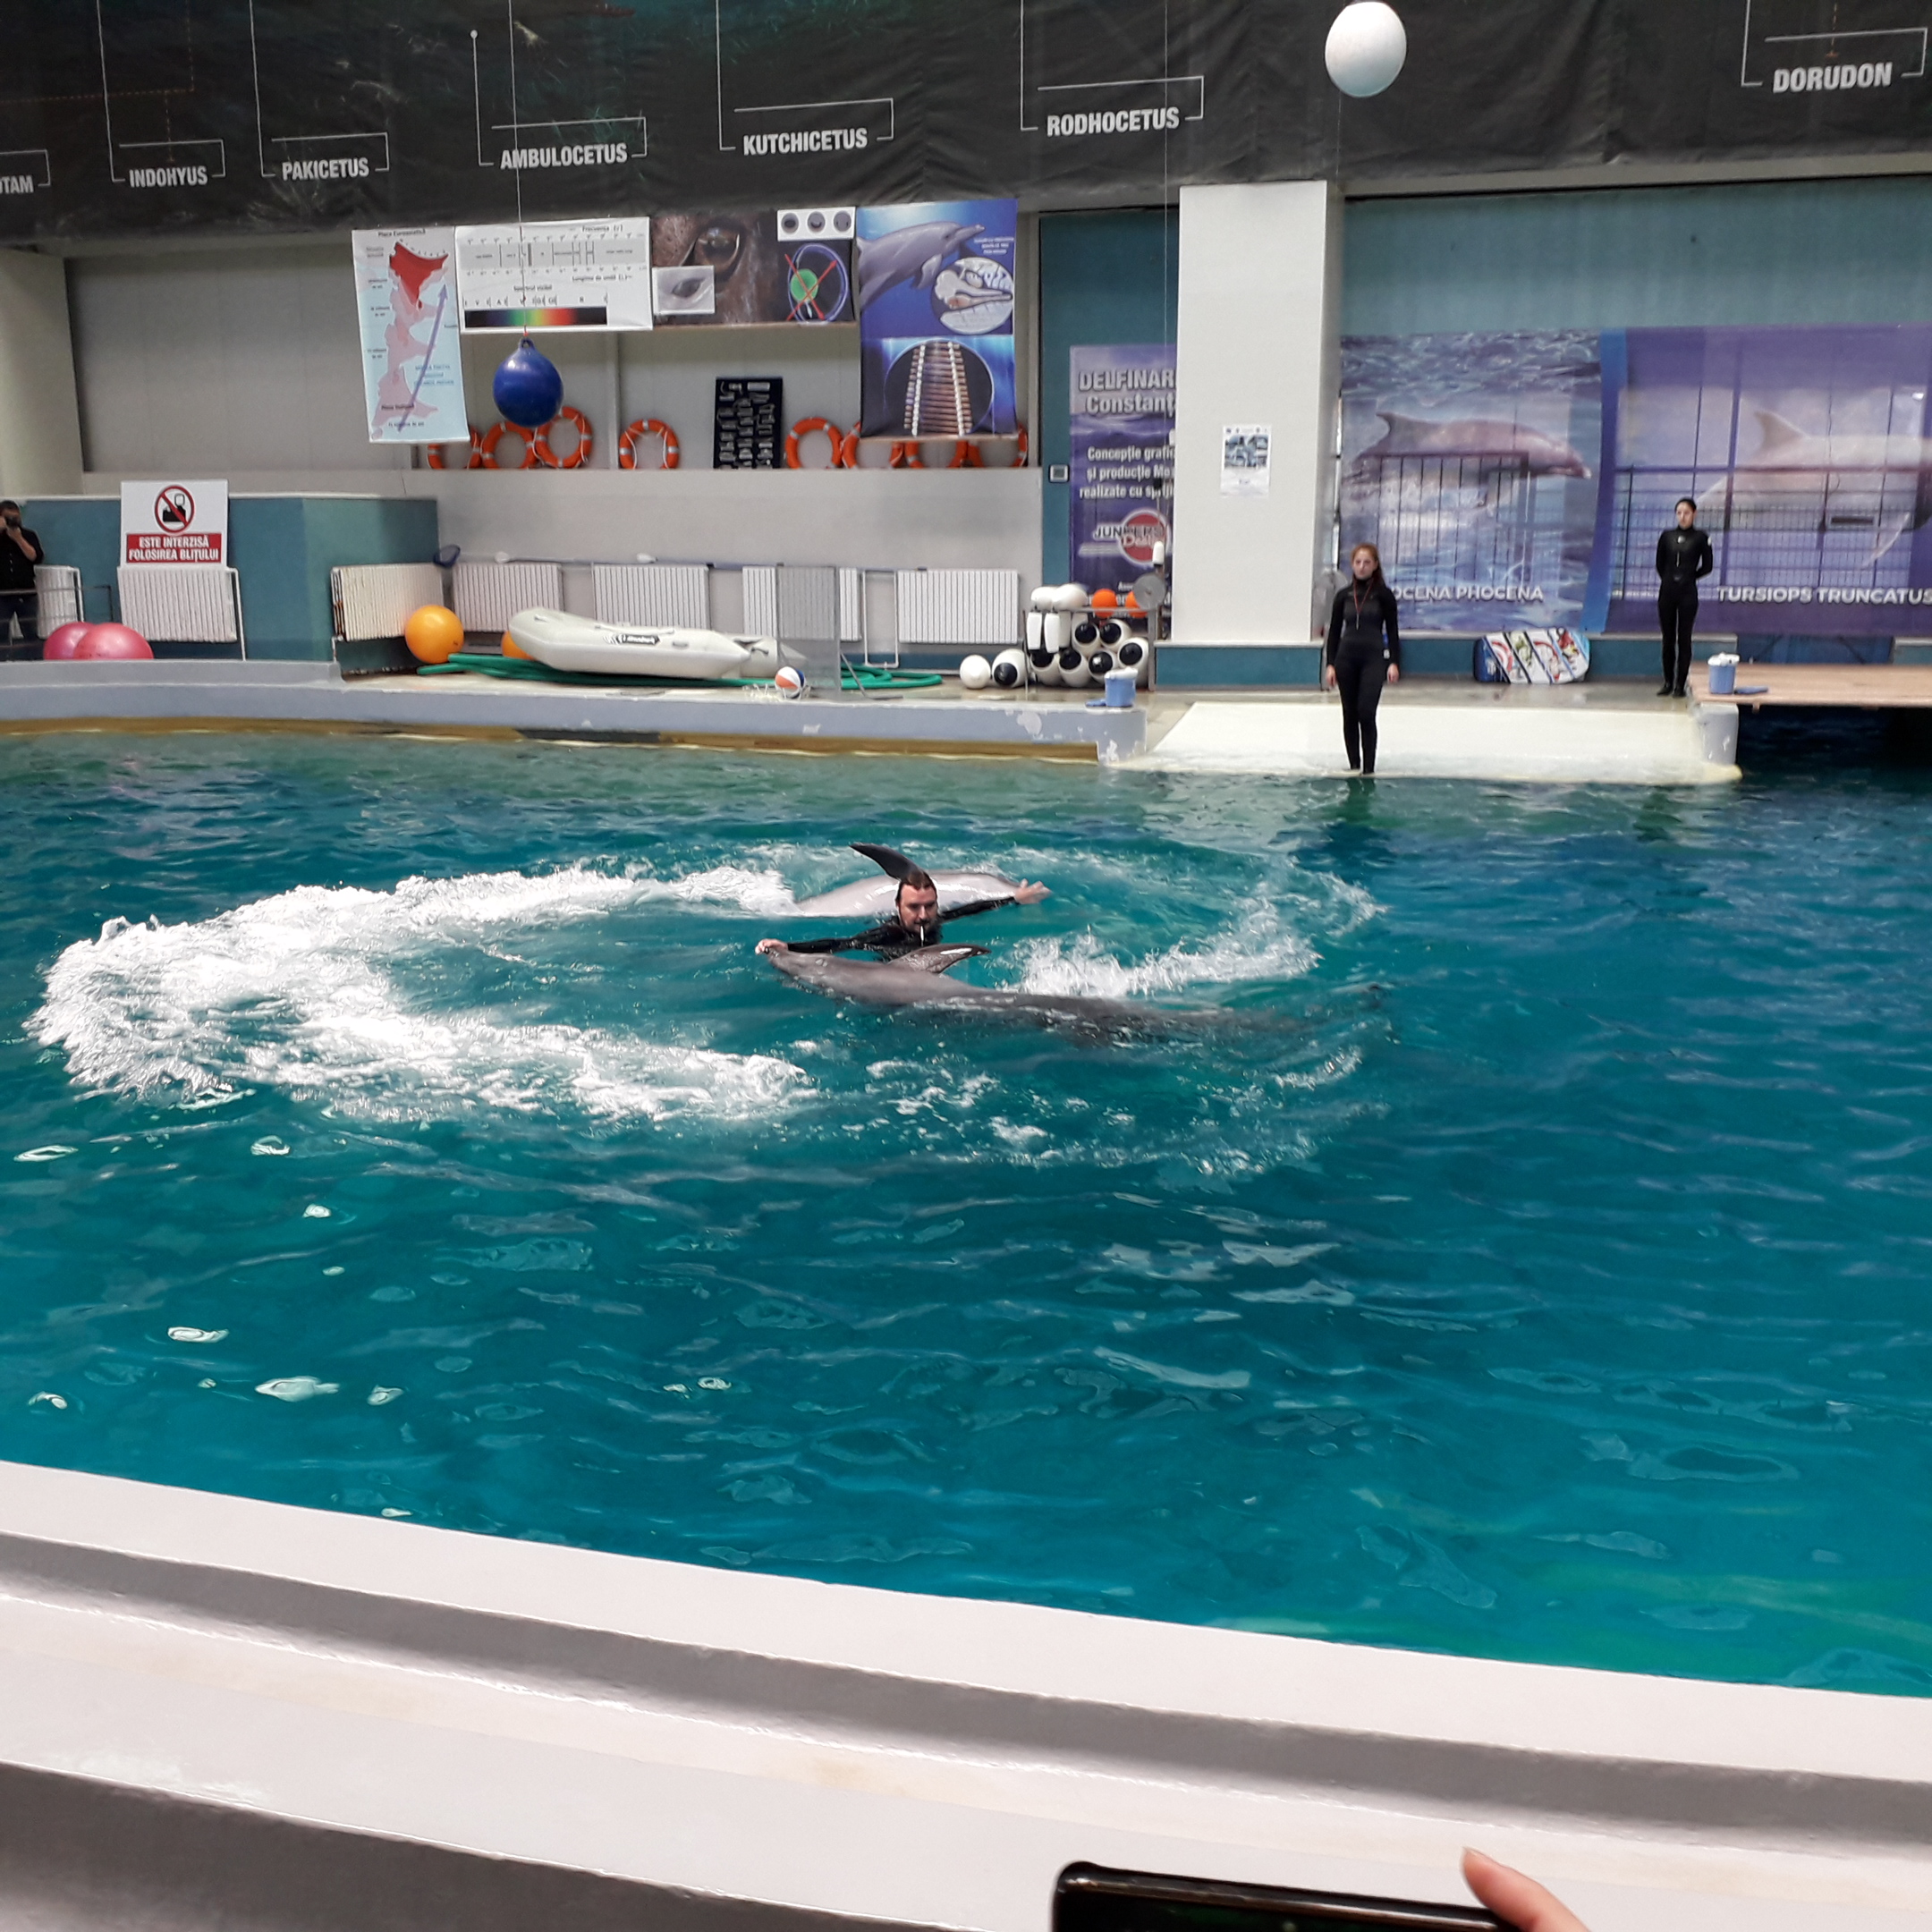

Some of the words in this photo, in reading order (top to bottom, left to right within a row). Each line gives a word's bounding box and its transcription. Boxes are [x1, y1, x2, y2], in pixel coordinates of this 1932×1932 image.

[1773, 62, 1893, 93] DORUDON
[1046, 106, 1180, 137] RODHOCETUS
[743, 128, 868, 156] KUTCHICETUS
[500, 143, 628, 169] AMBULOCETUS
[130, 165, 208, 188] INDOHYUS
[282, 157, 370, 181] PAKICETUS
[1086, 393, 1176, 418] Constanț
[1099, 465, 1151, 482] producție
[1079, 484, 1126, 499] realizate
[1129, 486, 1143, 498] cu
[139, 536, 161, 548] ESTE
[163, 534, 210, 548] INTERZISĂ
[129, 548, 178, 561] FOLOSIREA
[180, 548, 219, 563] BLIȚULUI
[1455, 584, 1546, 603] PHOCENA
[1717, 585, 1813, 605] TURSIOPS
[1816, 586, 1932, 606] TRUNCATUS
